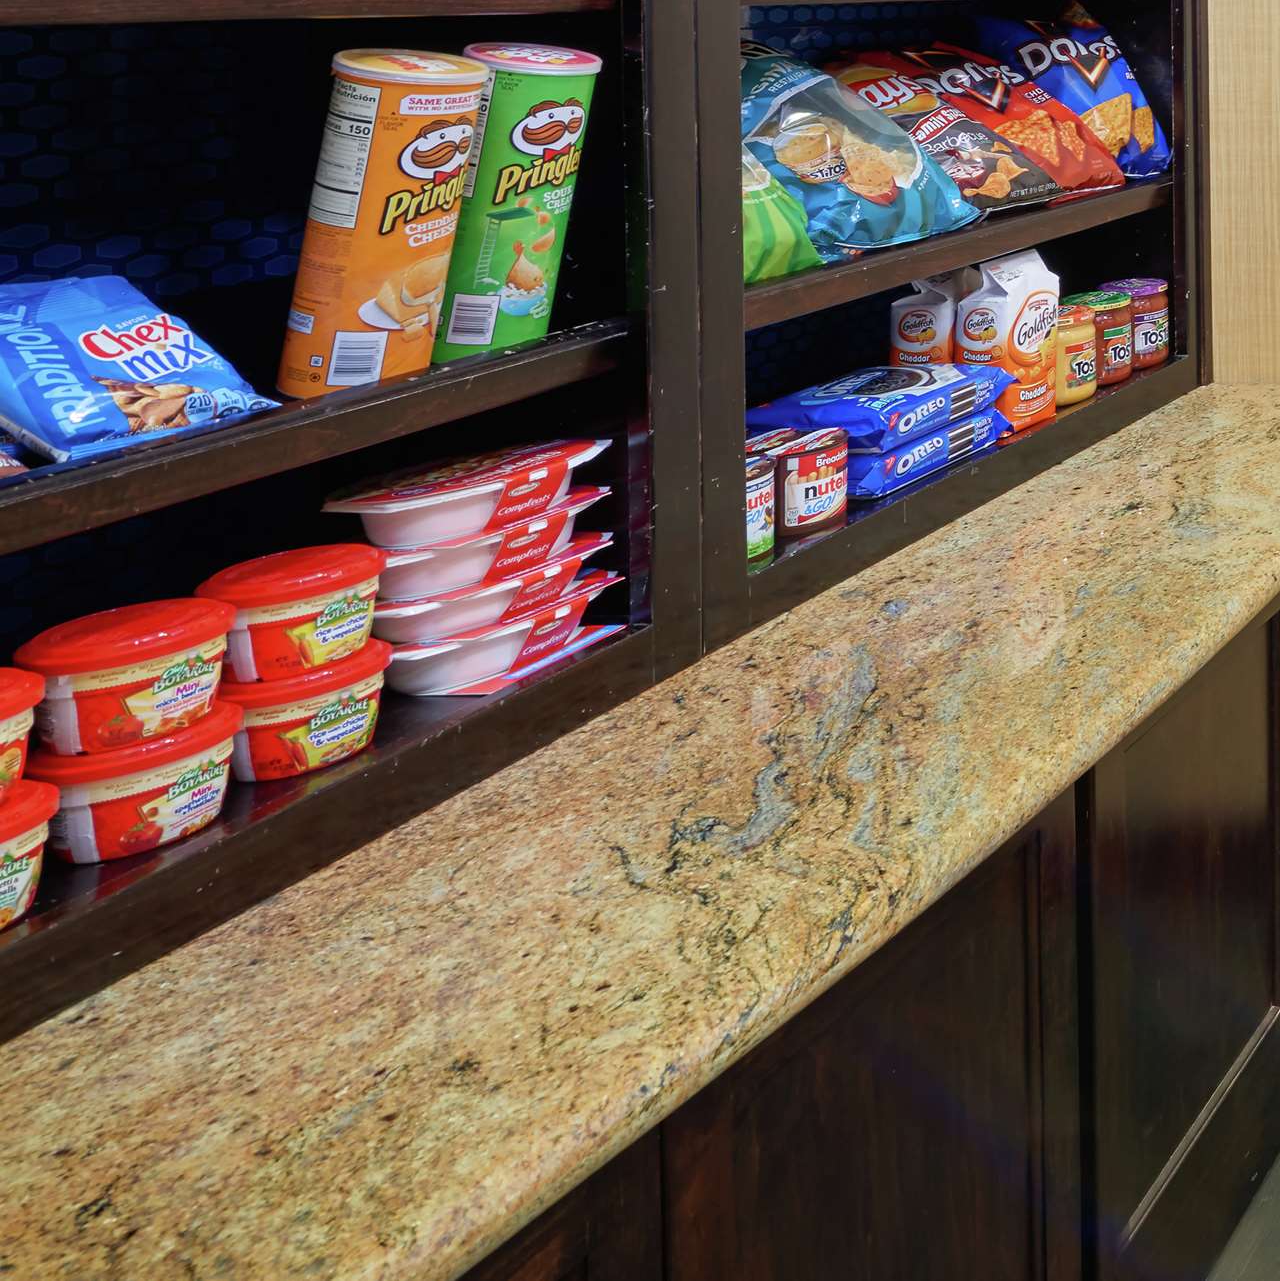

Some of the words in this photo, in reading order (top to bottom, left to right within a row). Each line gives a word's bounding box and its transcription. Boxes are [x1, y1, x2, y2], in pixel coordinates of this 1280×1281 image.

[408, 96, 443, 106] SAME
[444, 95, 473, 105] GREAT
[859, 76, 922, 109] ay's
[348, 124, 371, 137] 150
[380, 169, 467, 235] Pringl
[1018, 305, 1058, 346] Goldfish
[82, 314, 185, 360] Chex
[899, 351, 931, 364] Cheddar
[963, 351, 993, 362] Cheddar
[1020, 383, 1048, 401] Cheddar
[898, 396, 946, 434] OREO
[896, 436, 945, 476] OREO
[498, 493, 552, 516] Compleats
[496, 543, 551, 568] Compleats
[315, 628, 331, 639] rice
[176, 682, 200, 696] Mini
[308, 729, 326, 741] rice
[191, 784, 213, 799] Mini
